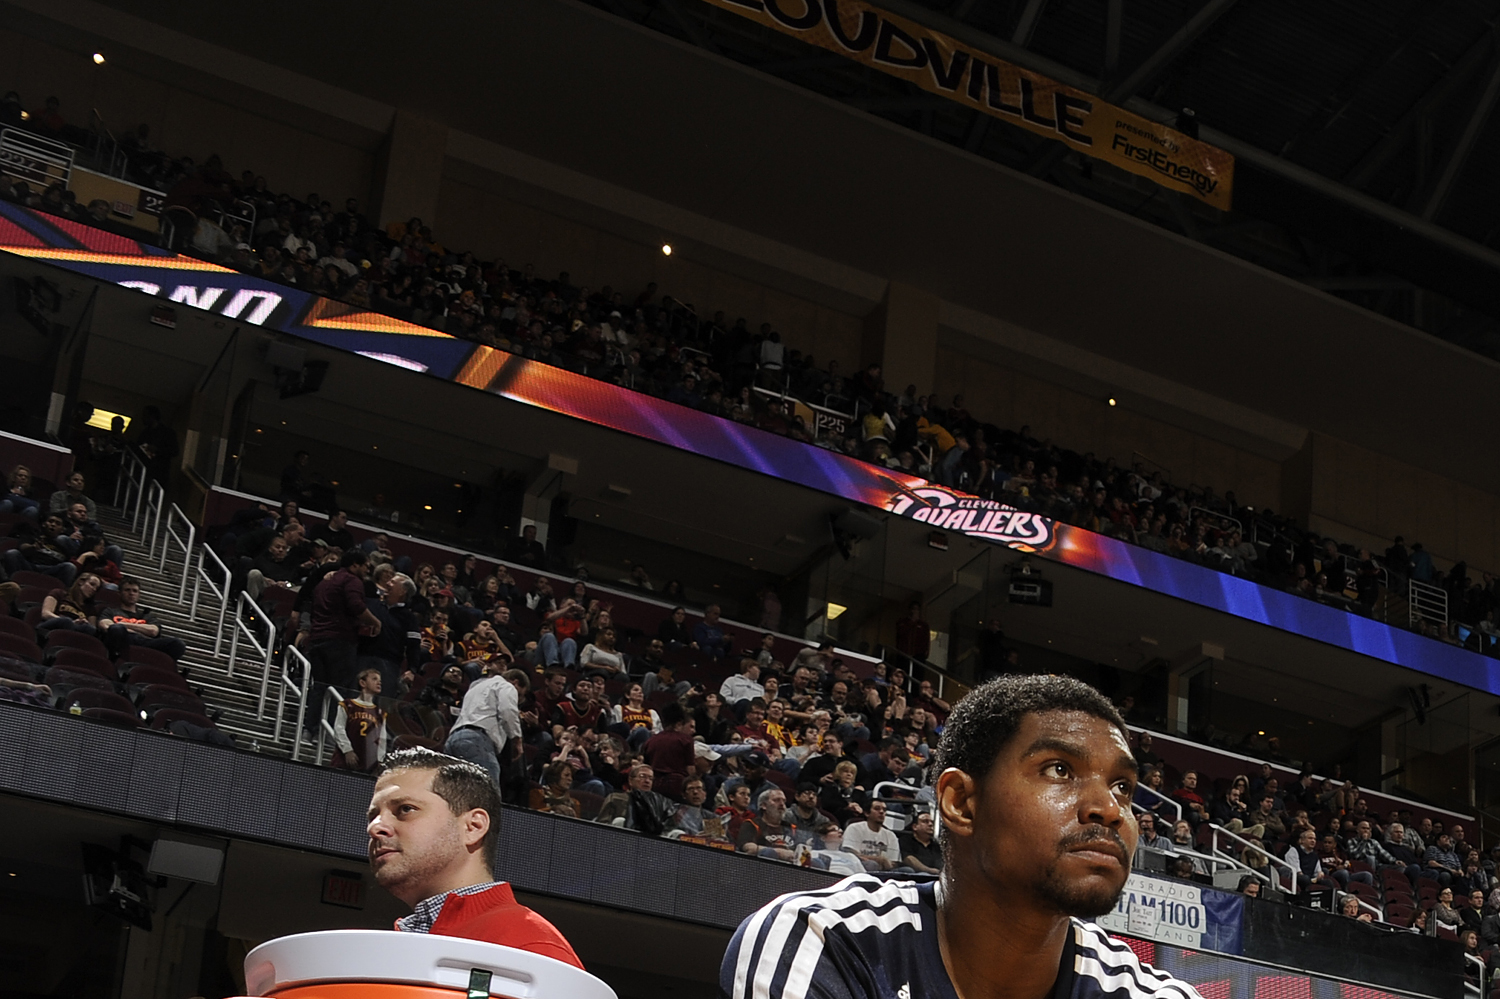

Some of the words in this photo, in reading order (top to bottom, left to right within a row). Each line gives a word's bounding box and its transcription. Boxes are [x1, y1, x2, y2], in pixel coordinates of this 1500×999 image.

[722, 0, 1094, 146] OUDVILLE
[1112, 133, 1218, 194] FirstEnergy
[360, 721, 368, 737] 2
